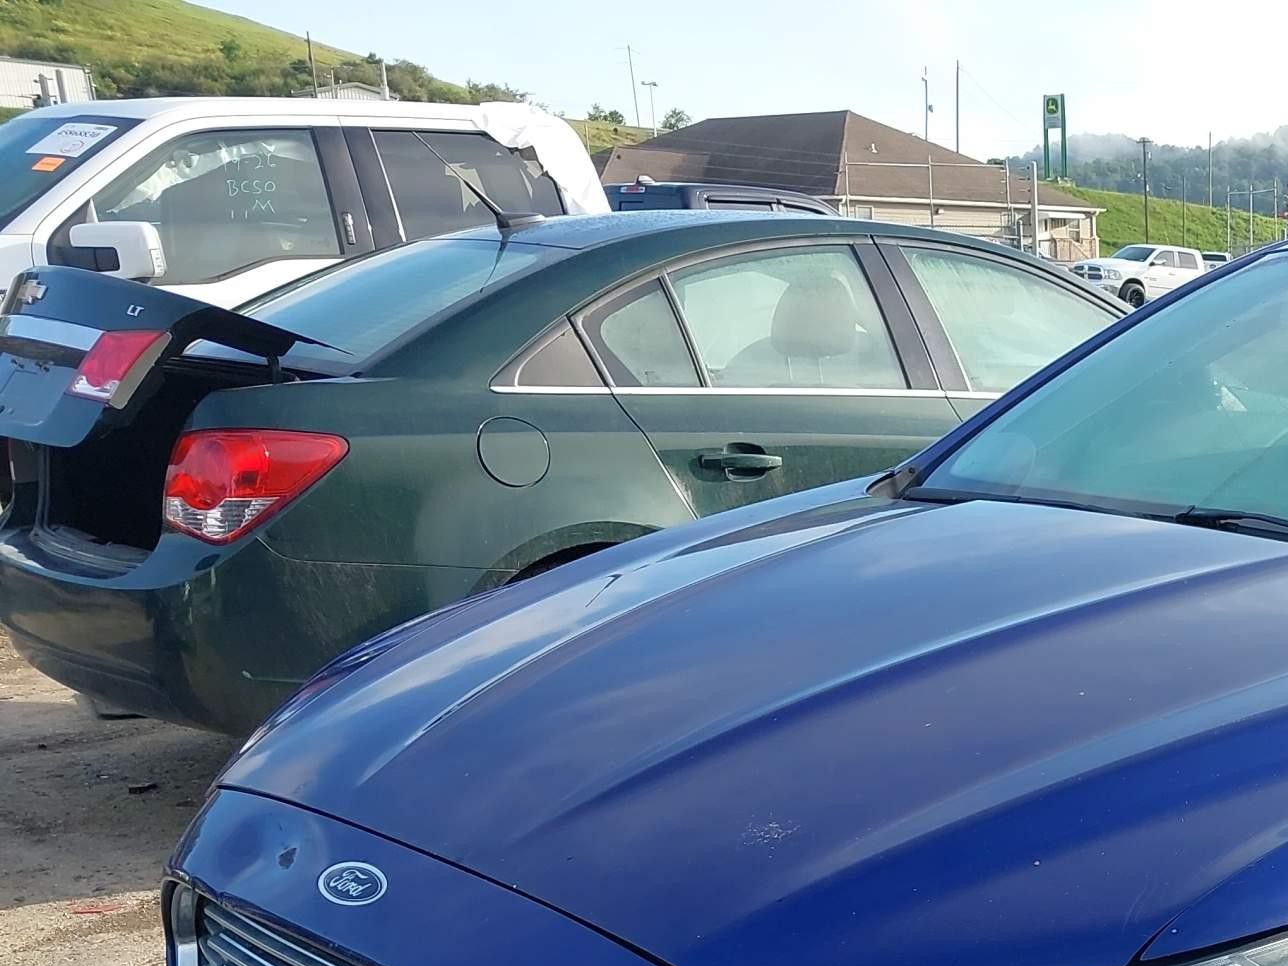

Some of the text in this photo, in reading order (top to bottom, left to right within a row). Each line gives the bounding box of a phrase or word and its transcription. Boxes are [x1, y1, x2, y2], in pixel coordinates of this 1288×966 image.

[226, 179, 276, 197] BCSO
[126, 304, 145, 318] LT
[329, 869, 372, 897] Ford
